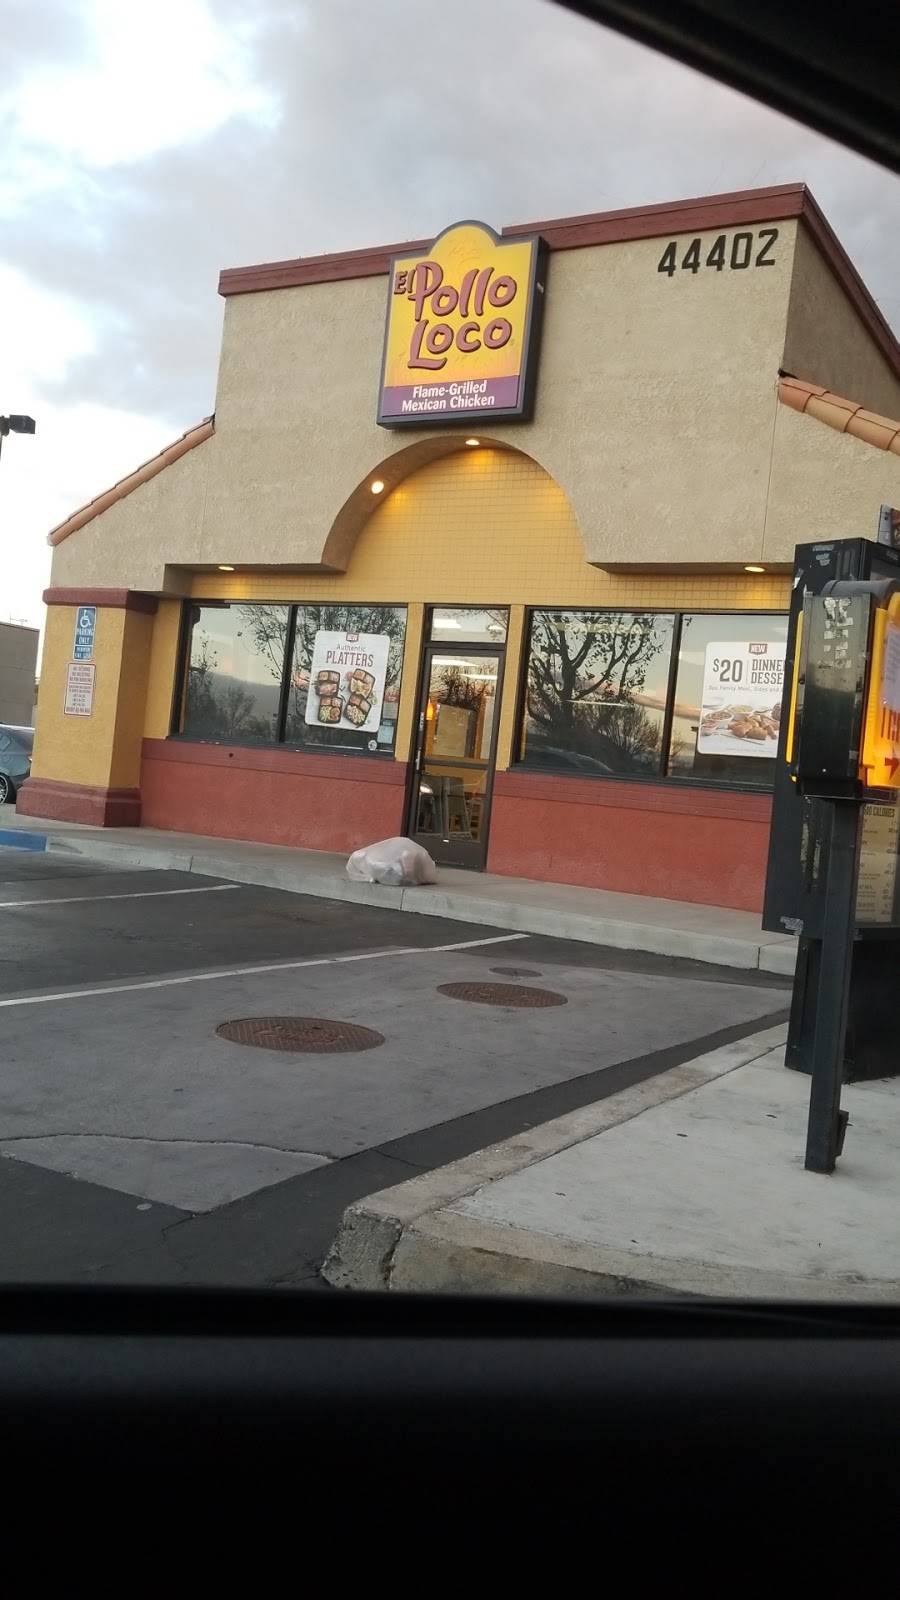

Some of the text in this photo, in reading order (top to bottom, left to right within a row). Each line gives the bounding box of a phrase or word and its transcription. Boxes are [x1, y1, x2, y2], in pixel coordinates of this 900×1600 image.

[657, 228, 779, 277] 44402
[393, 260, 518, 322] El Pollo
[412, 380, 488, 399] Flame-Grilled
[402, 394, 495, 413] Mexican Chicken
[750, 644, 766, 653] NEW
[325, 650, 374, 667] PLATTERS
[713, 658, 785, 682] $20 DINNE
